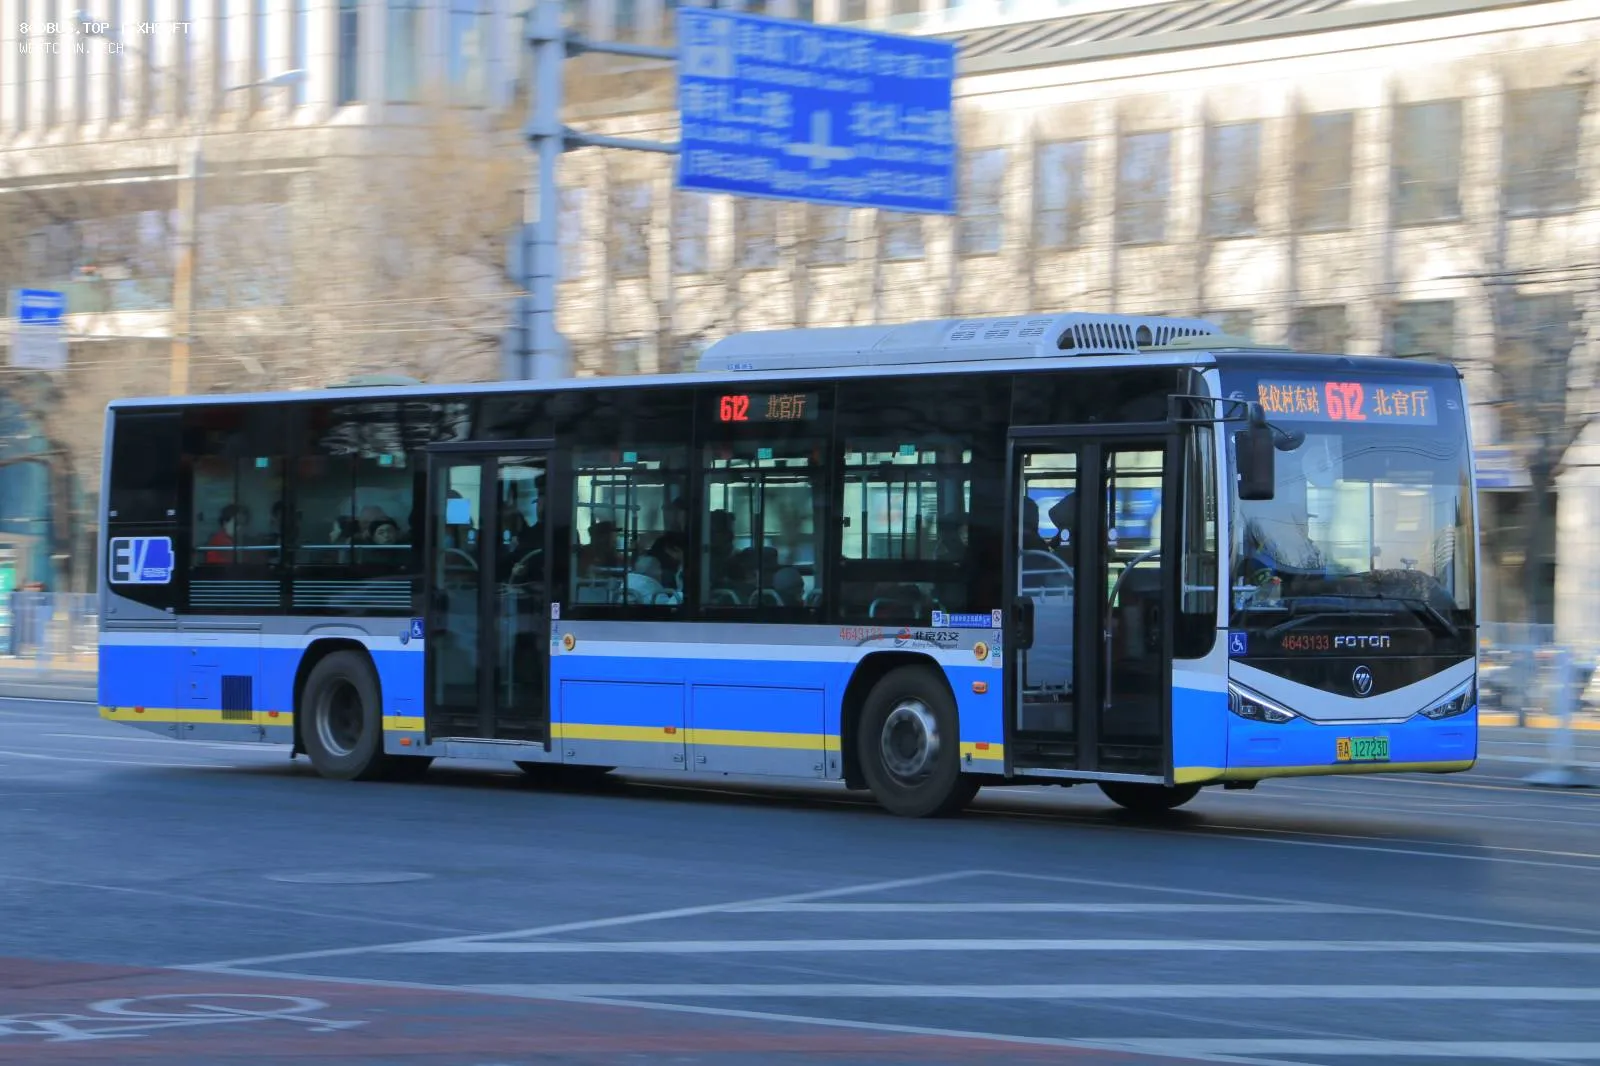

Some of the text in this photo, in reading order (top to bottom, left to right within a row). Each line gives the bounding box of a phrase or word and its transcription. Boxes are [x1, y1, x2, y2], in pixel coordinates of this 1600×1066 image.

[720, 394, 807, 421] 612 北官厅
[1325, 382, 1367, 421] 612
[1373, 388, 1430, 417] 北官厅
[913, 630, 960, 642] 北京公交
[1281, 634, 1391, 650] 4643133 FOTON
